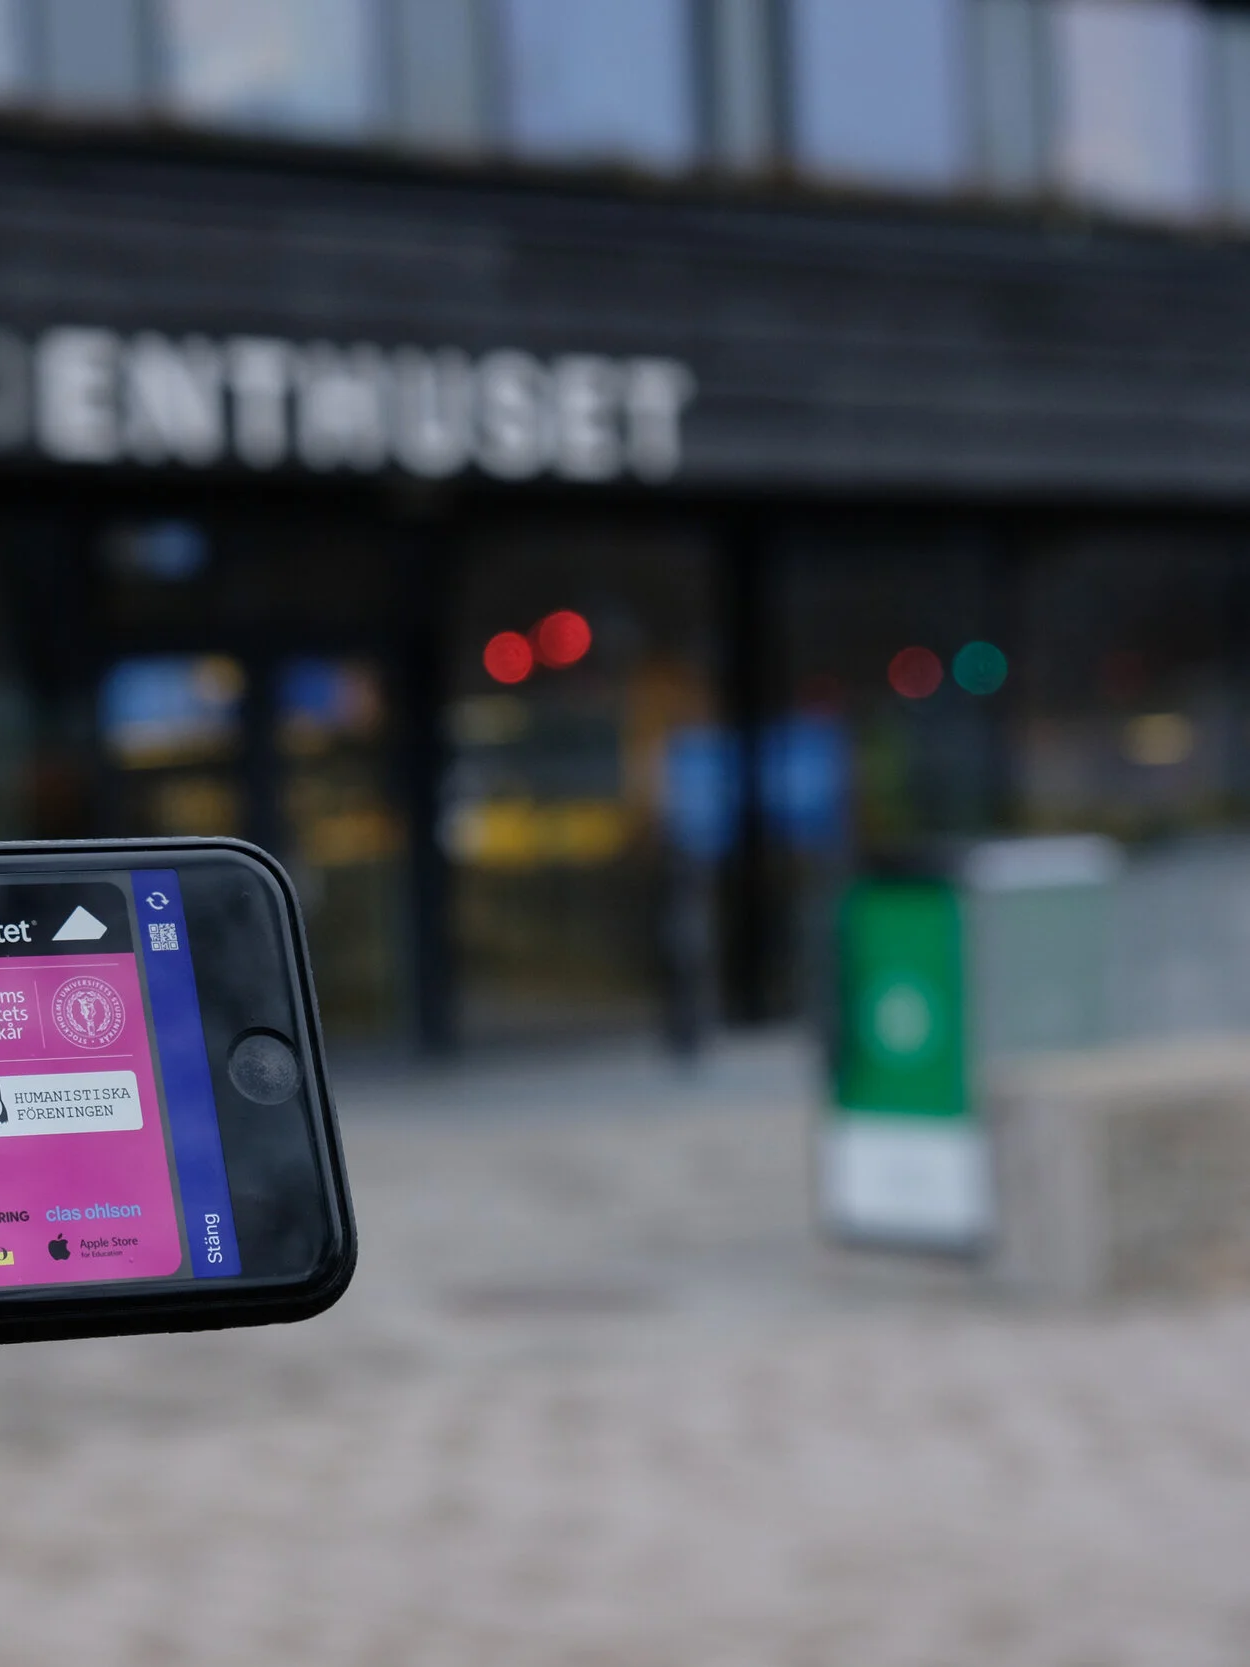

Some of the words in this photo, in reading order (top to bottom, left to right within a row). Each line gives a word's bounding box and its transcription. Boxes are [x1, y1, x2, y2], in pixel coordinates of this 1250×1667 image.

[14, 1088, 132, 1105] HUMANISTISKA
[16, 1104, 115, 1121] FÖRENINGEN
[46, 1206, 82, 1222] clas
[85, 1202, 142, 1219] ohlson
[80, 1236, 109, 1250] Apple
[111, 1236, 139, 1247] Store
[204, 1213, 223, 1264] Stäng
